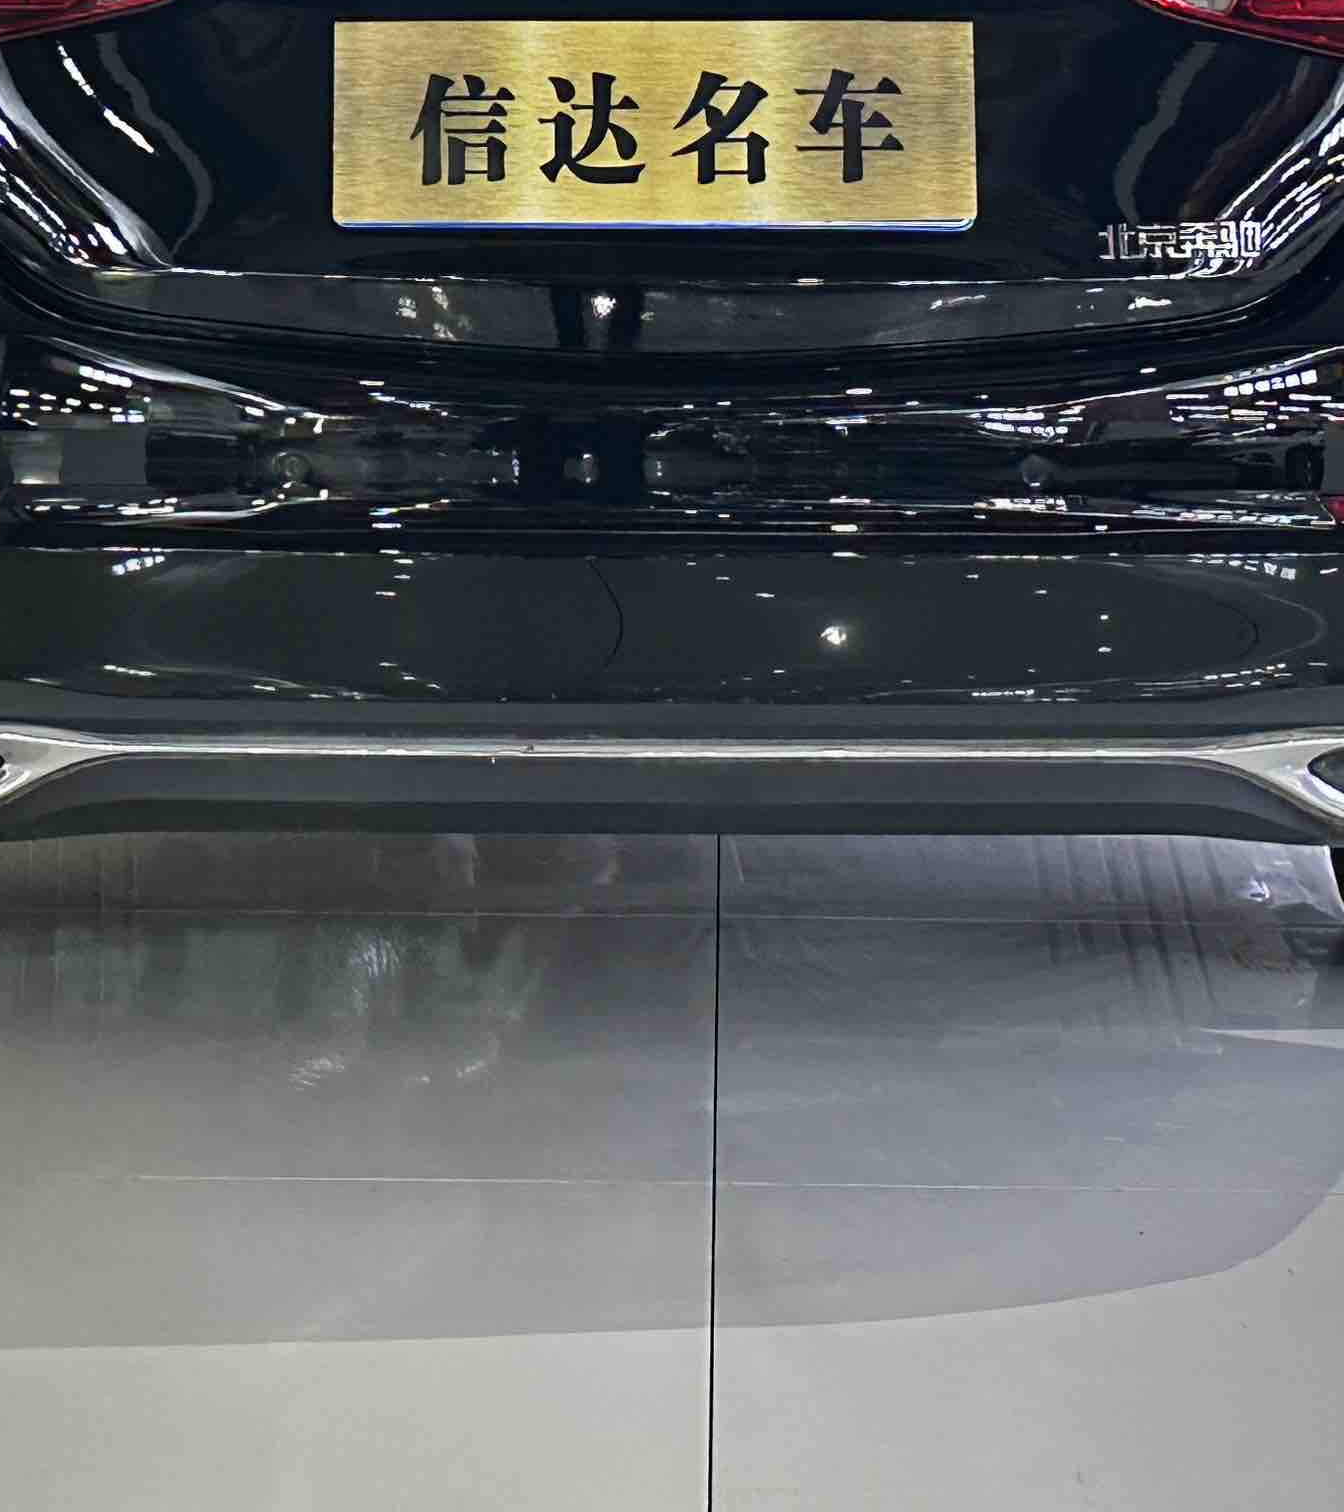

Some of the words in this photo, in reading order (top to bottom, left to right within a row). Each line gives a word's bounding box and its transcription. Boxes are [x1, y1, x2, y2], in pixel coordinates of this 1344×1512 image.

[408, 68, 904, 187] 信达名车
[1098, 220, 1261, 260] 北京奔驰
